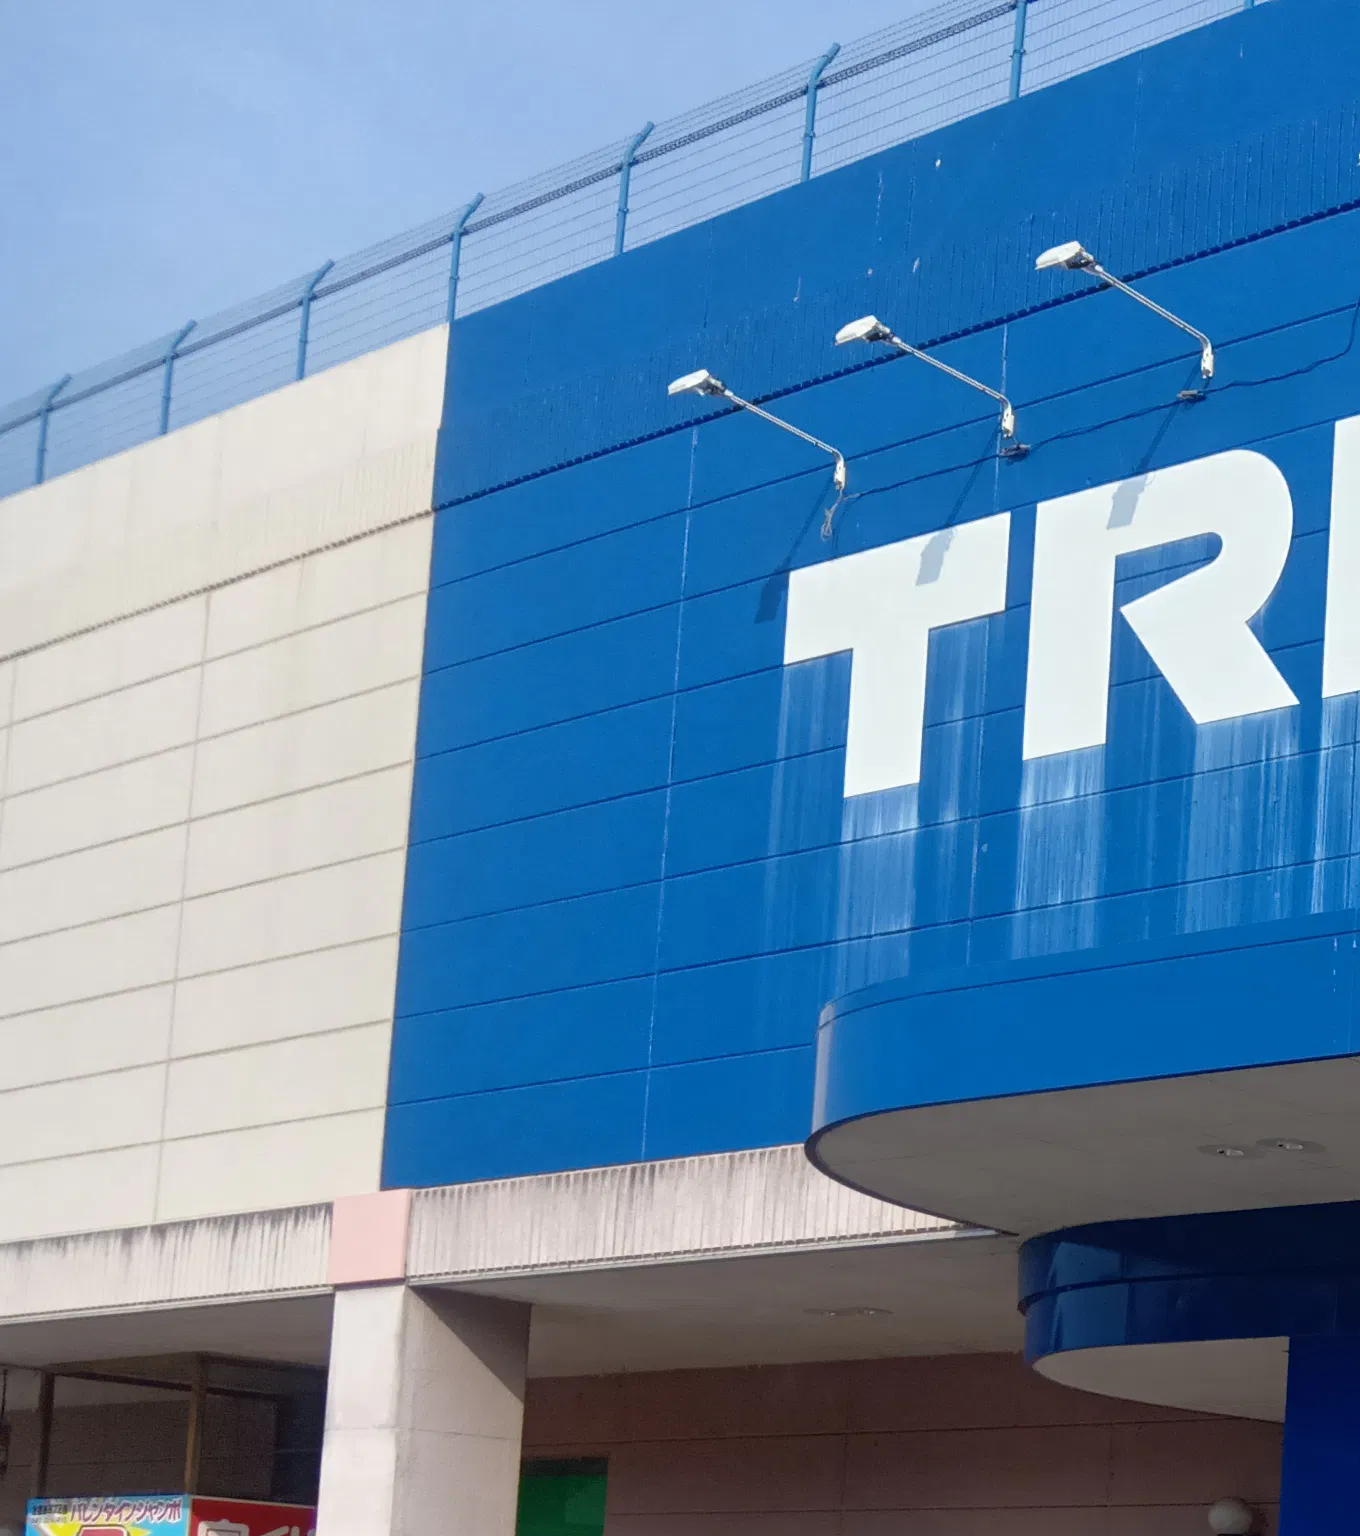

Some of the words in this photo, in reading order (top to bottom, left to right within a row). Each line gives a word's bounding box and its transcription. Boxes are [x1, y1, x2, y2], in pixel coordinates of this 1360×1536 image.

[70, 1498, 184, 1524] バレンタインジャンボ
